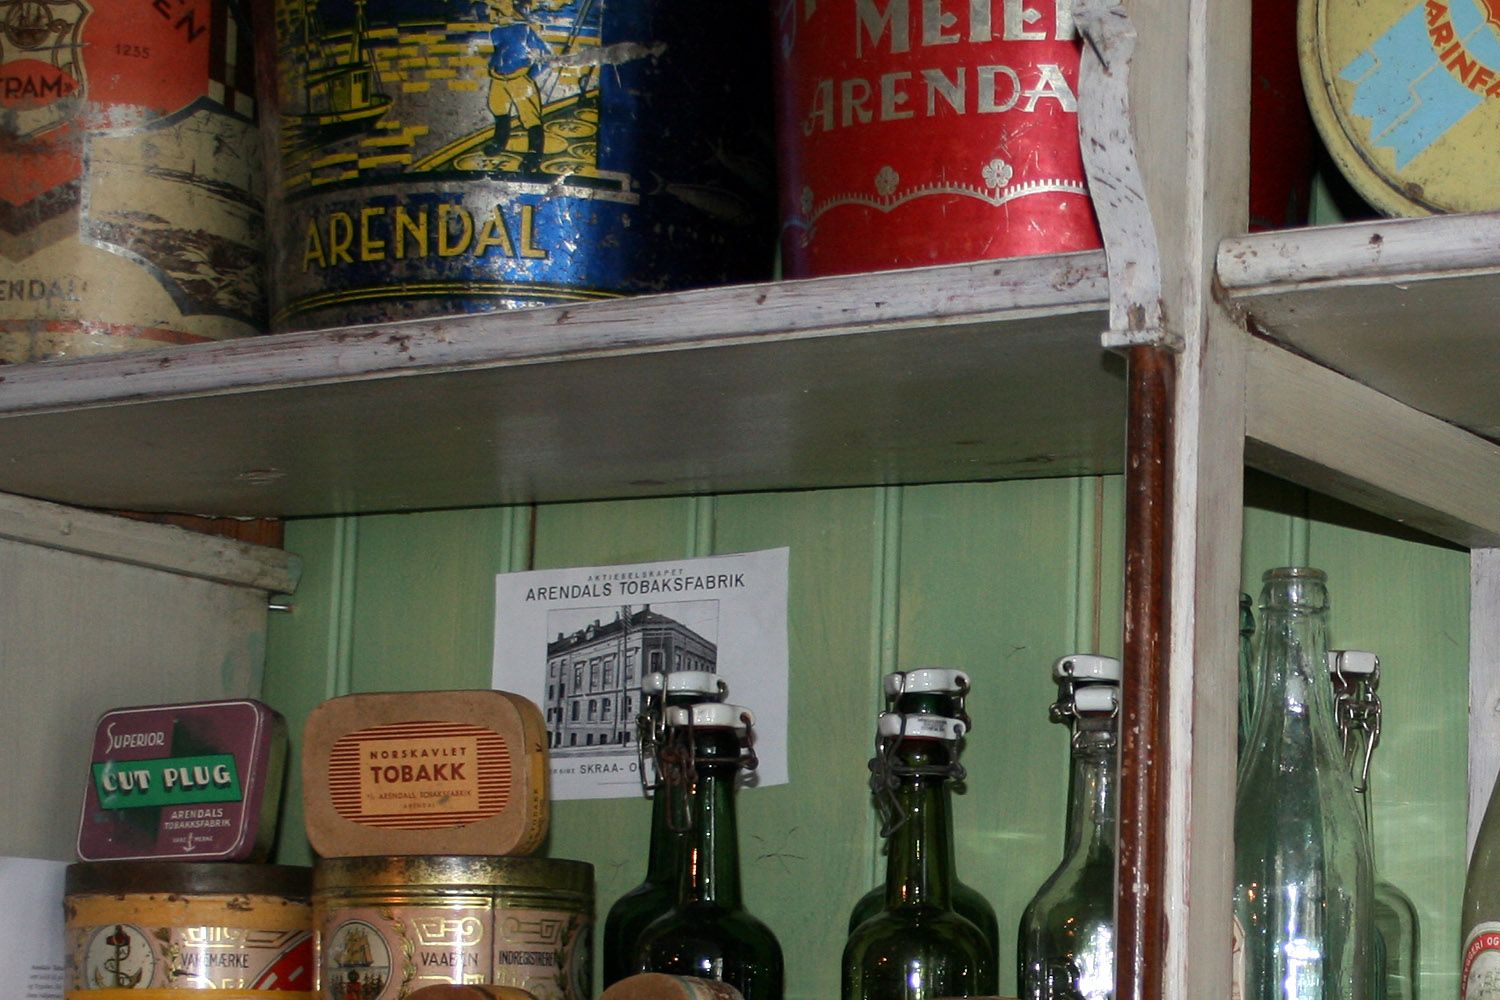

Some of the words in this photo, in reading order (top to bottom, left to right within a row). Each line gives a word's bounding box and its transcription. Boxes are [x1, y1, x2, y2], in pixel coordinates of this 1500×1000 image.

[301, 203, 550, 272] ARENDAL
[587, 568, 684, 582] AKTIESELSKAPET
[525, 581, 612, 602] ARENDALS
[619, 573, 746, 596] TOBAKSFABRIK
[369, 746, 468, 761] NORSKAVLET
[370, 760, 468, 785] TOBAKK
[579, 763, 624, 775] SKRAA-
[102, 767, 152, 794] CUT
[163, 763, 232, 791] PLUG
[171, 808, 224, 820] ARENDALS
[1486, 936, 1500, 947] OG
